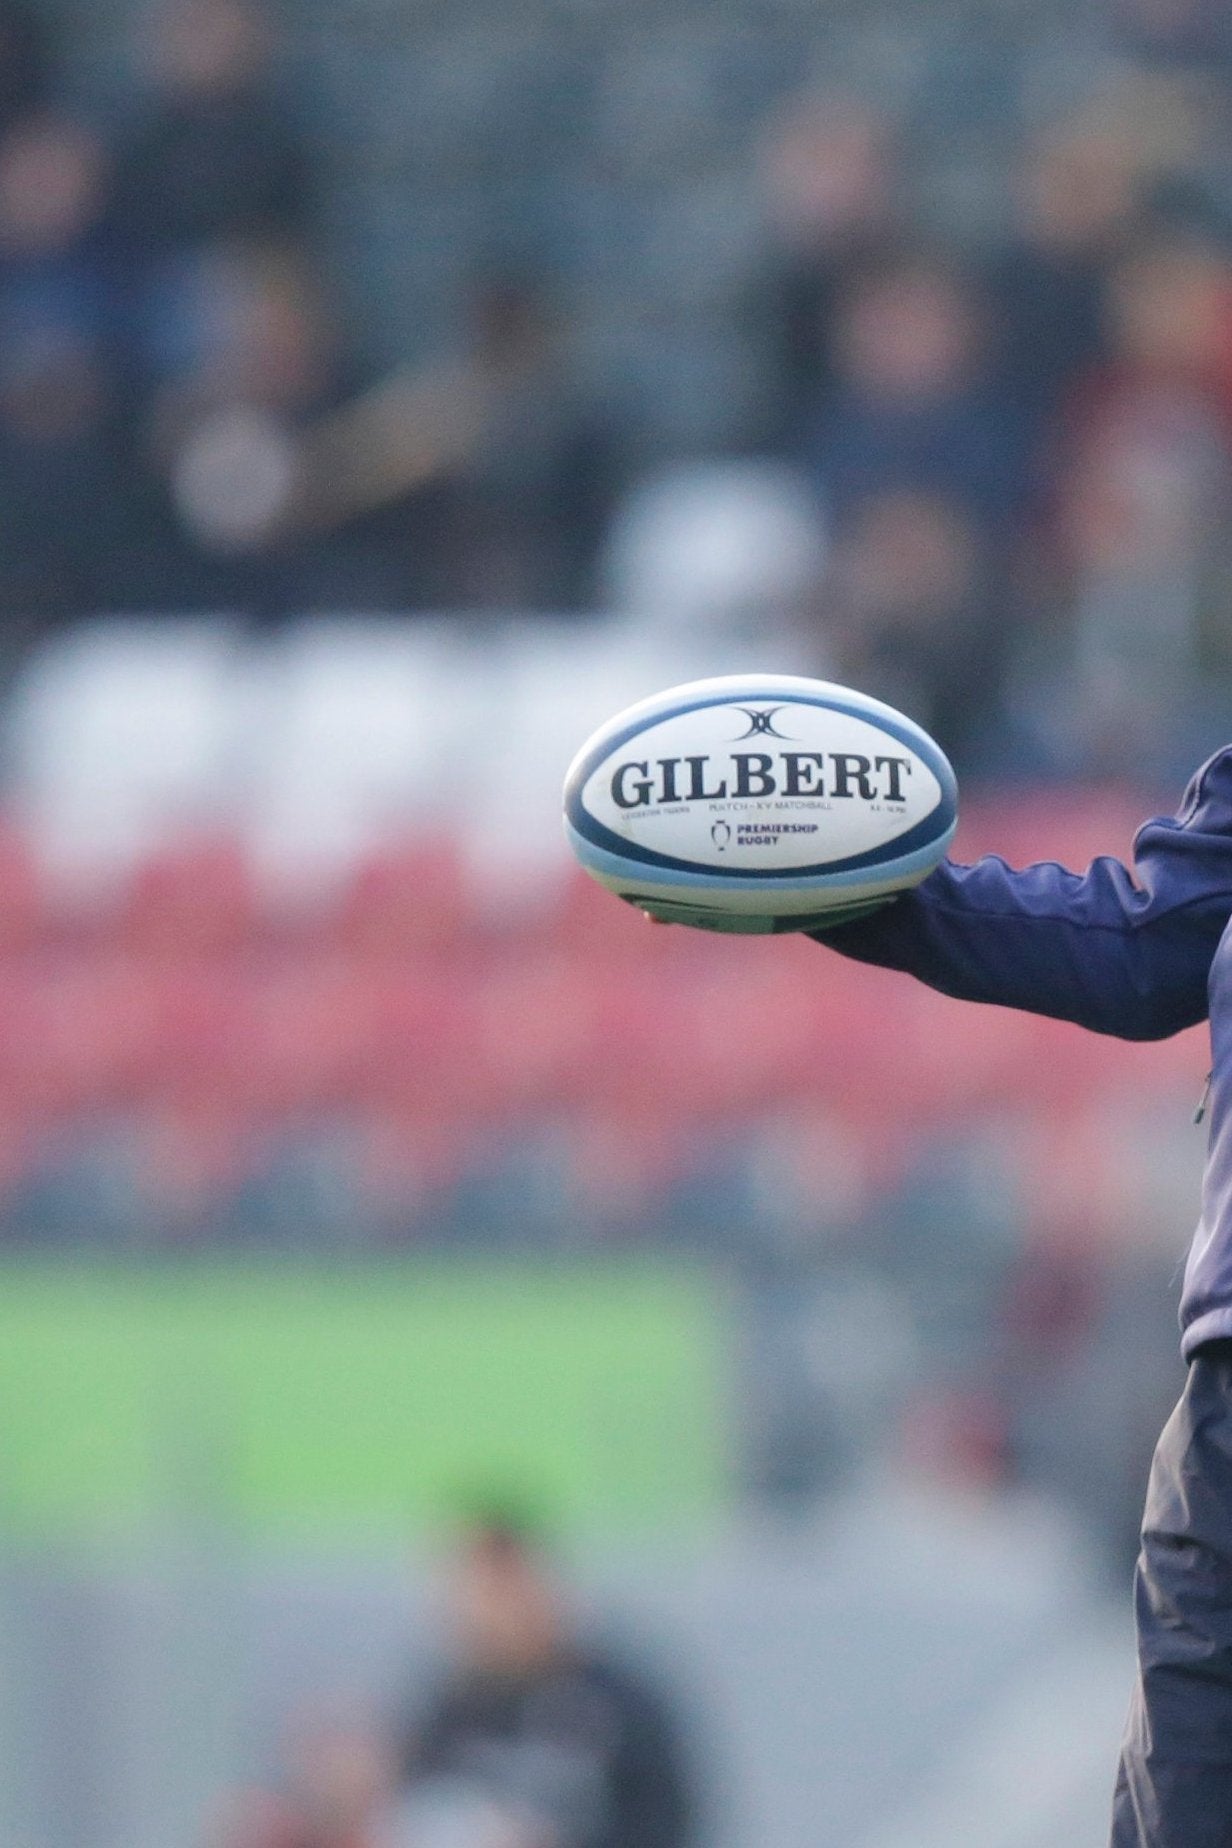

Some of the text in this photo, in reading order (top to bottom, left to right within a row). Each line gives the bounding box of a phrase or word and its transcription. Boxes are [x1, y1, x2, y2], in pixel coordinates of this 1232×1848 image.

[610, 751, 913, 810] GILBERT
[736, 823, 820, 834] PREMIERSHIP
[736, 836, 780, 846] RUGBY
